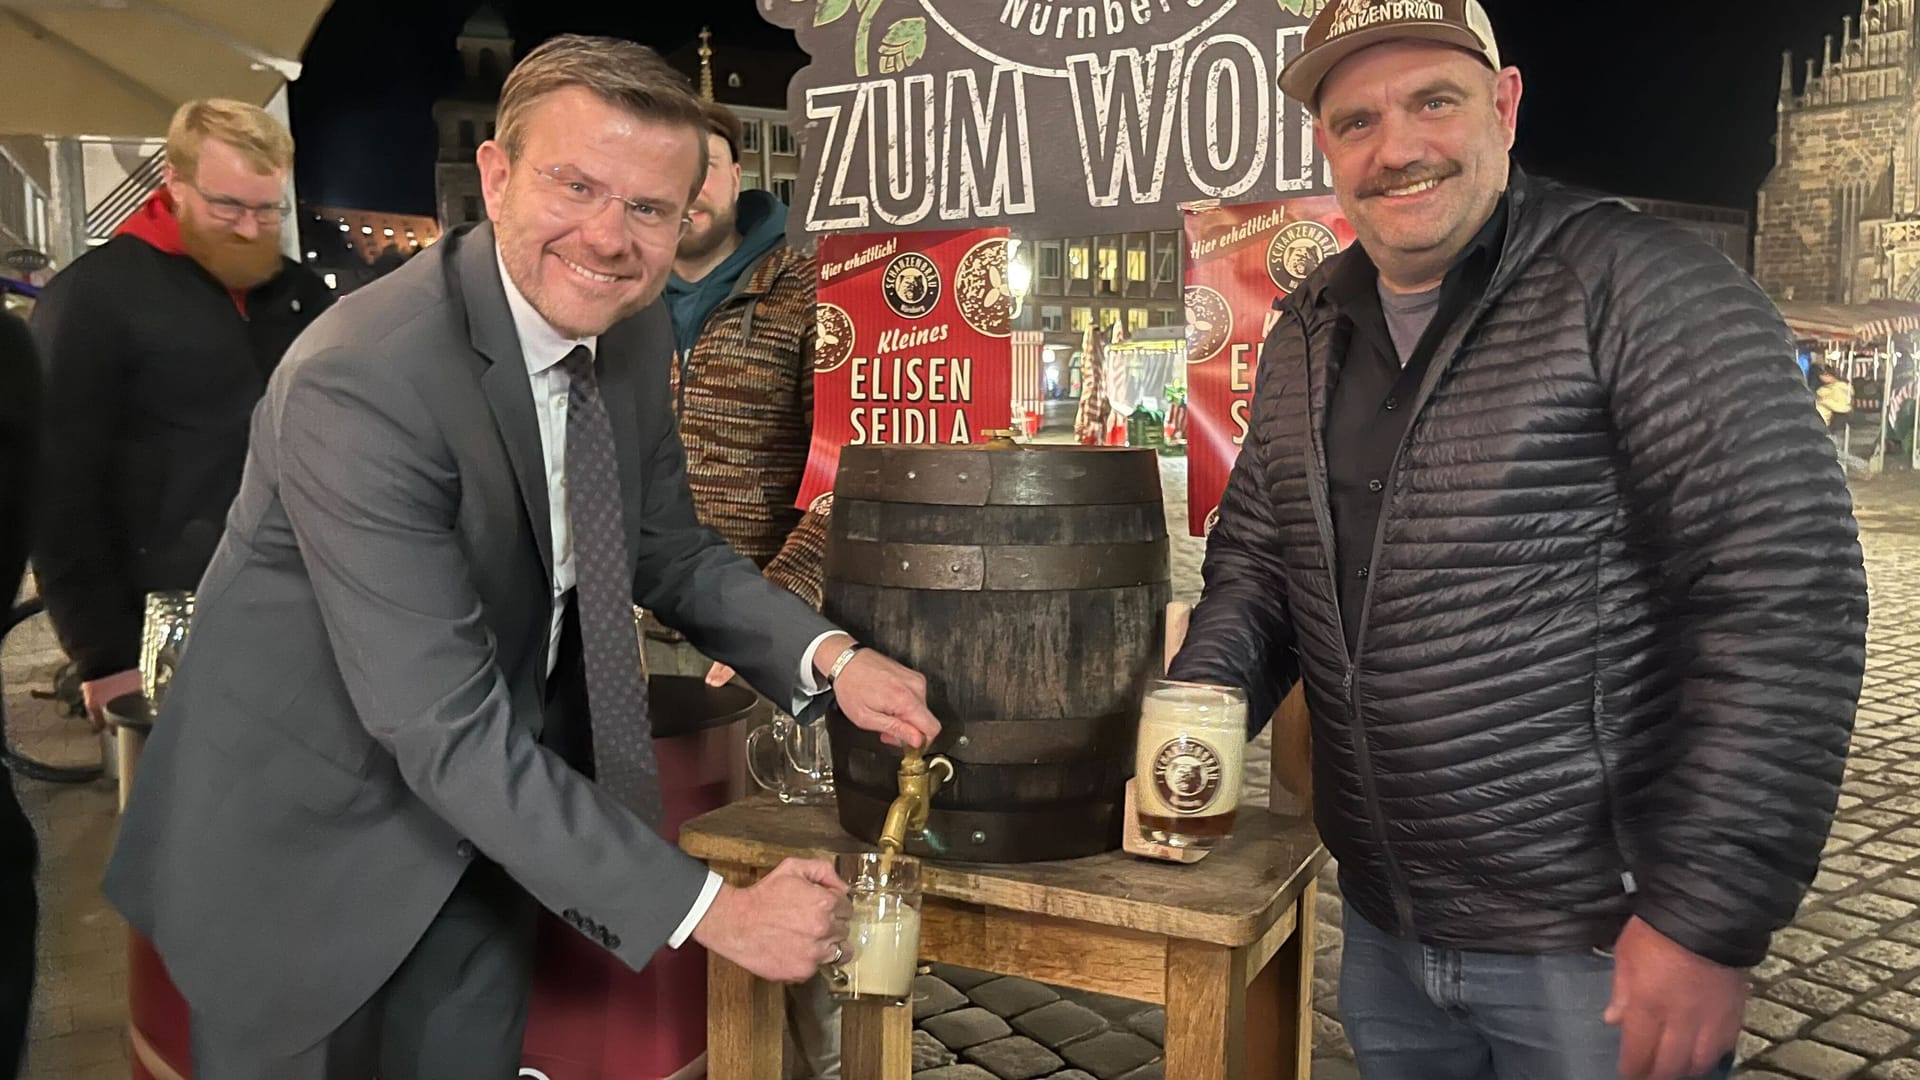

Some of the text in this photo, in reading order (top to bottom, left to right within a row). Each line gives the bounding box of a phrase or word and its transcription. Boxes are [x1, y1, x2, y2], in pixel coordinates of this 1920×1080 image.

[1000, 0, 1204, 38] Nürnbe
[805, 65, 1035, 232] ZUM
[1190, 205, 1285, 260] Hier erhältlich!
[821, 237, 897, 281] Hier erhältlich!
[877, 323, 949, 355] Kleines
[851, 357, 972, 402] ELISEN
